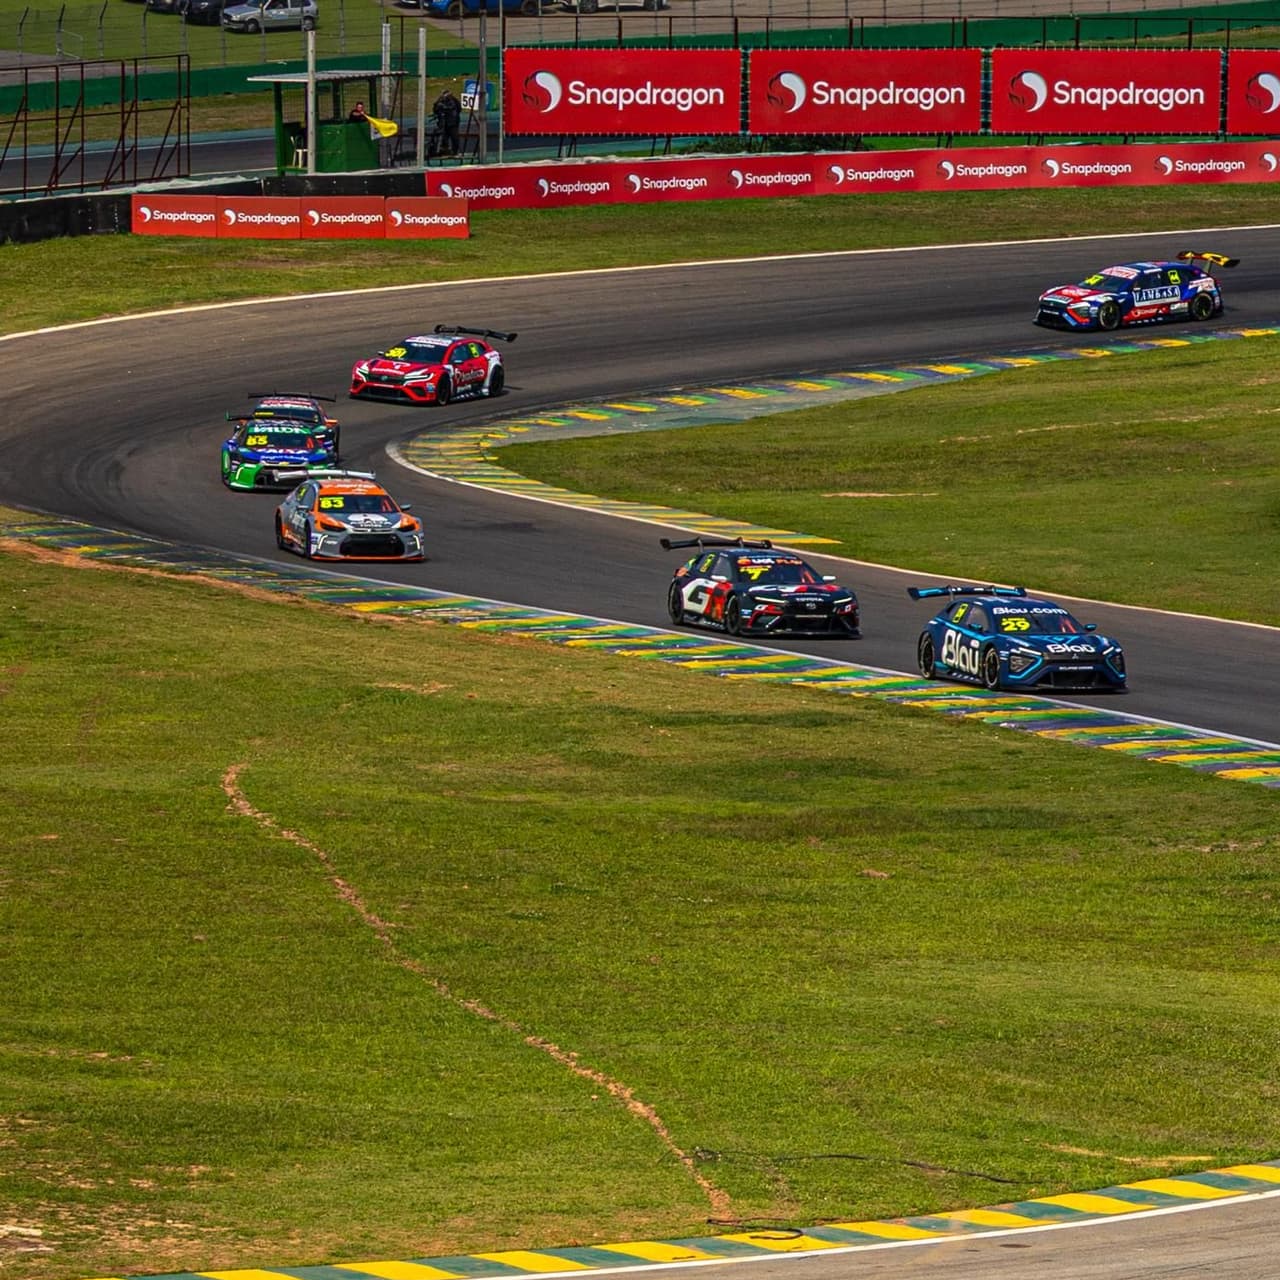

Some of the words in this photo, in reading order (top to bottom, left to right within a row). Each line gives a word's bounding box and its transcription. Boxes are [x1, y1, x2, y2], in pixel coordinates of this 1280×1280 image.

[568, 81, 724, 111] Snapdragon
[813, 81, 964, 110] Snapdragon
[1054, 81, 1204, 110] Snapdragon
[957, 164, 1027, 177] Snapdragon
[1062, 162, 1131, 176] Snapdragon
[1176, 160, 1245, 173] Snapdragon
[745, 172, 811, 186] Snapdragon
[847, 168, 914, 182] Snapdragon
[551, 181, 609, 194] Snapdragon
[643, 177, 707, 190] Snapdragon
[455, 186, 514, 199] Snapdragon
[153, 210, 215, 223] Snapdragon
[238, 213, 299, 225] Snapdragon
[321, 213, 382, 224] Snapdragon
[404, 214, 466, 226] Snapdragon
[1002, 620, 1031, 632] 29
